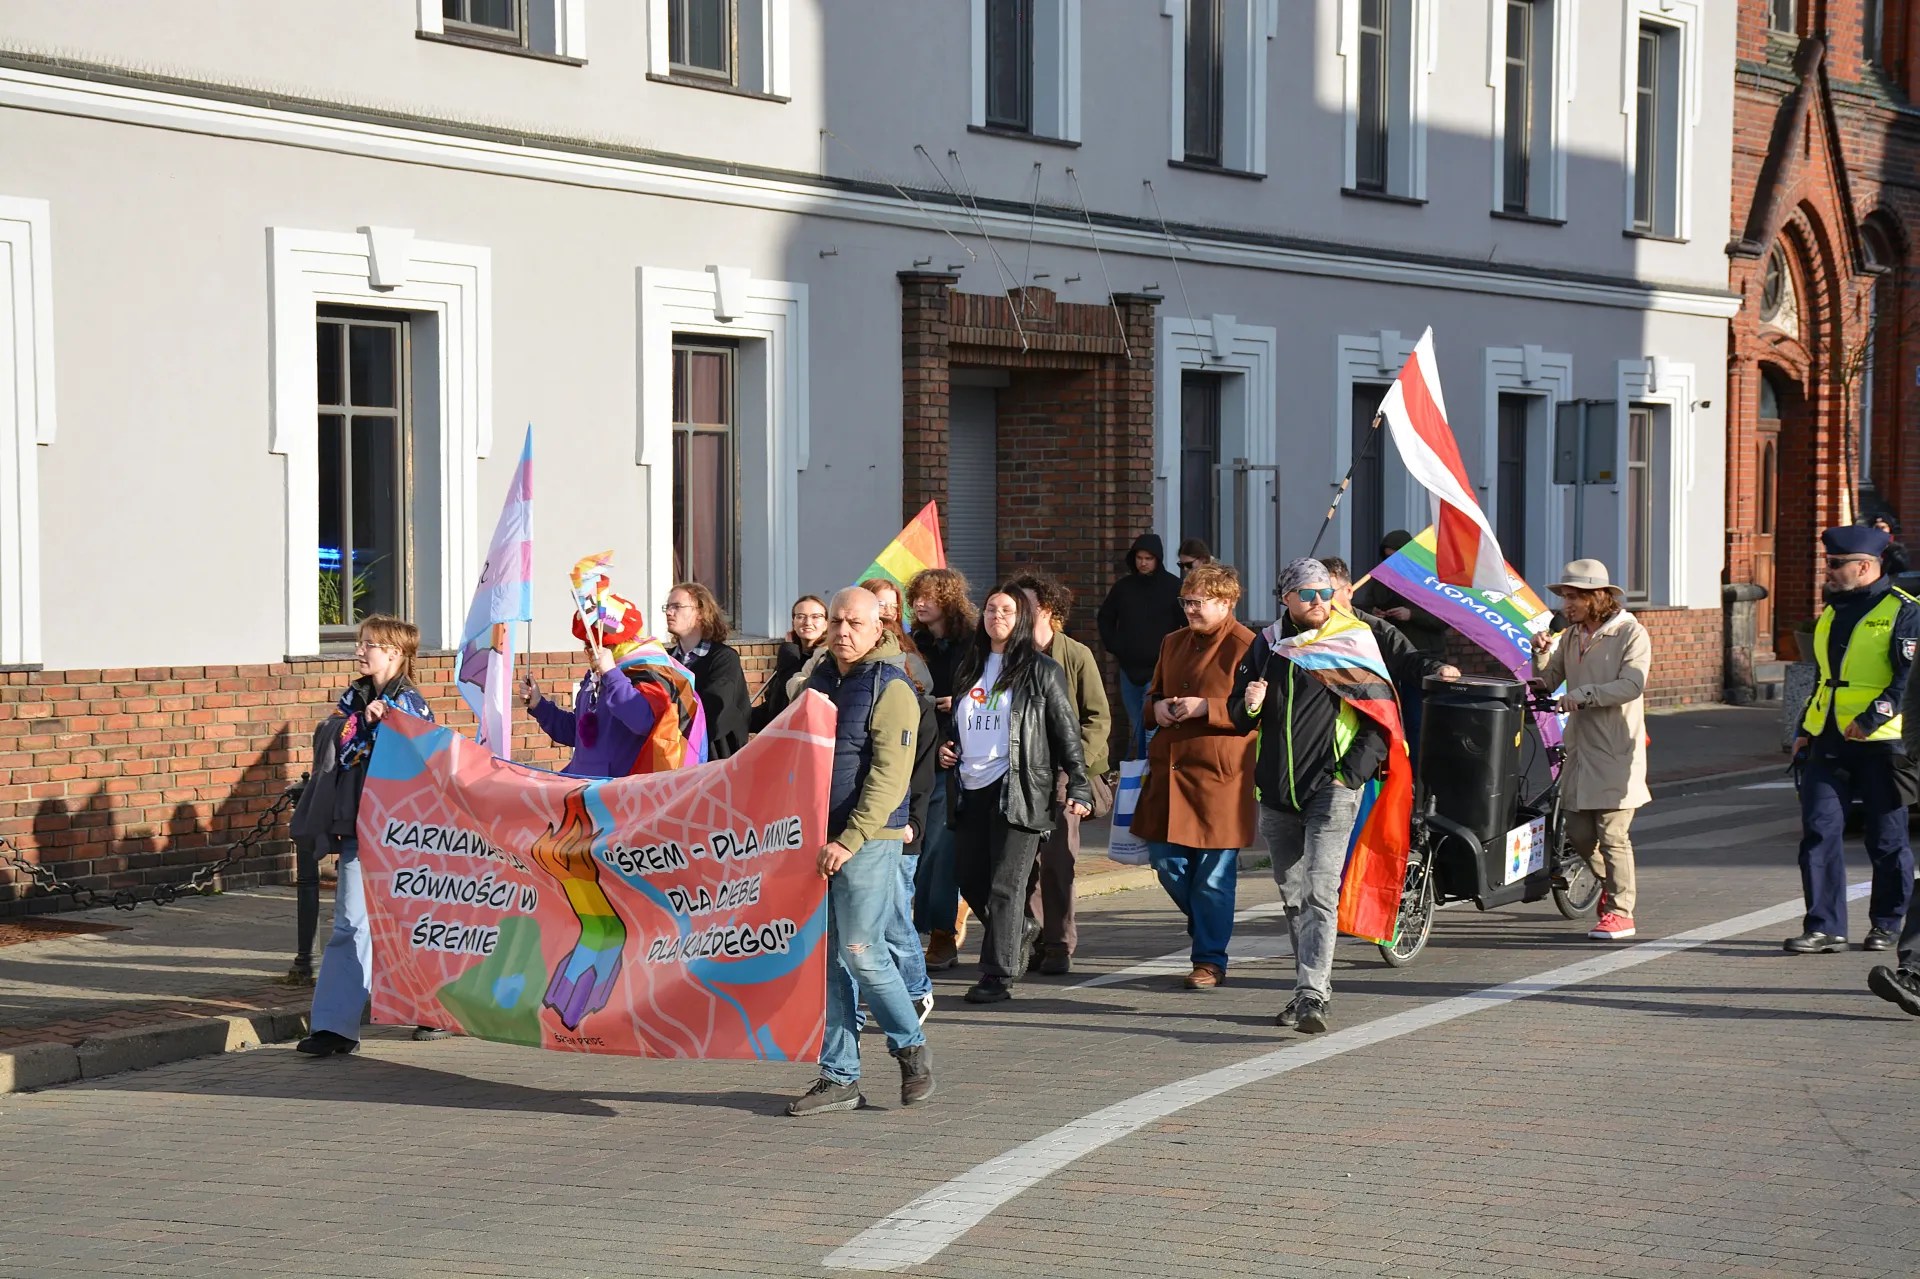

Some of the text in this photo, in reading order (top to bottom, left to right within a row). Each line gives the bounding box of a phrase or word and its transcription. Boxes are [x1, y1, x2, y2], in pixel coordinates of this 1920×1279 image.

[967, 708, 1001, 731] ŚREM
[712, 829, 758, 859] DLA
[762, 819, 801, 849] MNIE
[394, 867, 537, 911] RÓWNOŚCI W
[668, 876, 760, 912] DLA CIEBIE
[412, 916, 498, 954] ŚREMIE
[648, 923, 795, 962] DLA KAŻDEGO!"
